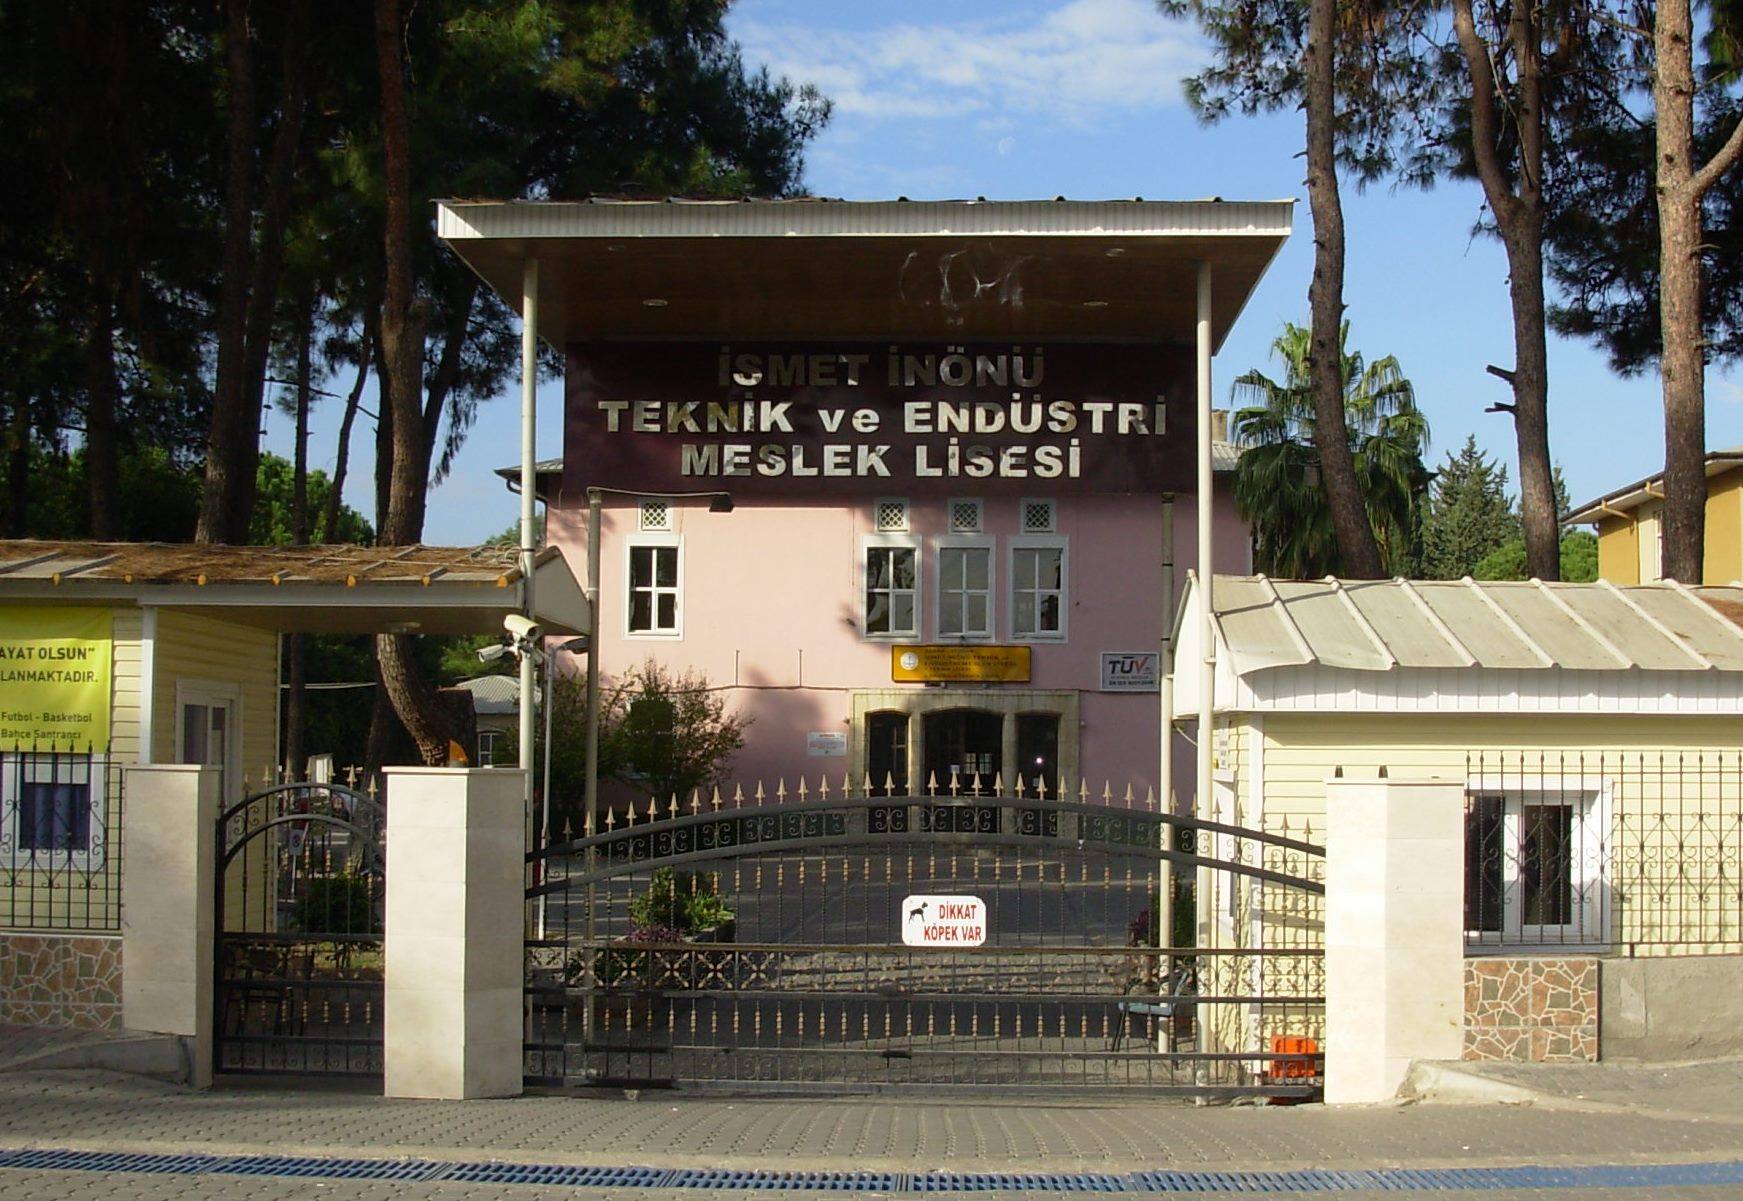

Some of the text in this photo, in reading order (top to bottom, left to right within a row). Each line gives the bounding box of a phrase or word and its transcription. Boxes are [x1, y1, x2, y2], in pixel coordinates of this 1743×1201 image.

[718, 346, 1043, 387] İSMET İNÖNÜ
[598, 392, 1166, 435] TEKNİK ve ENDÜSTRİ
[681, 437, 1080, 477] MESLEK LİSESİ
[1108, 656, 1149, 675] TÜV
[1, 711, 33, 722] Futbol
[43, 712, 92, 723] Basketbol
[924, 923, 982, 941] KÖPEK VAR
